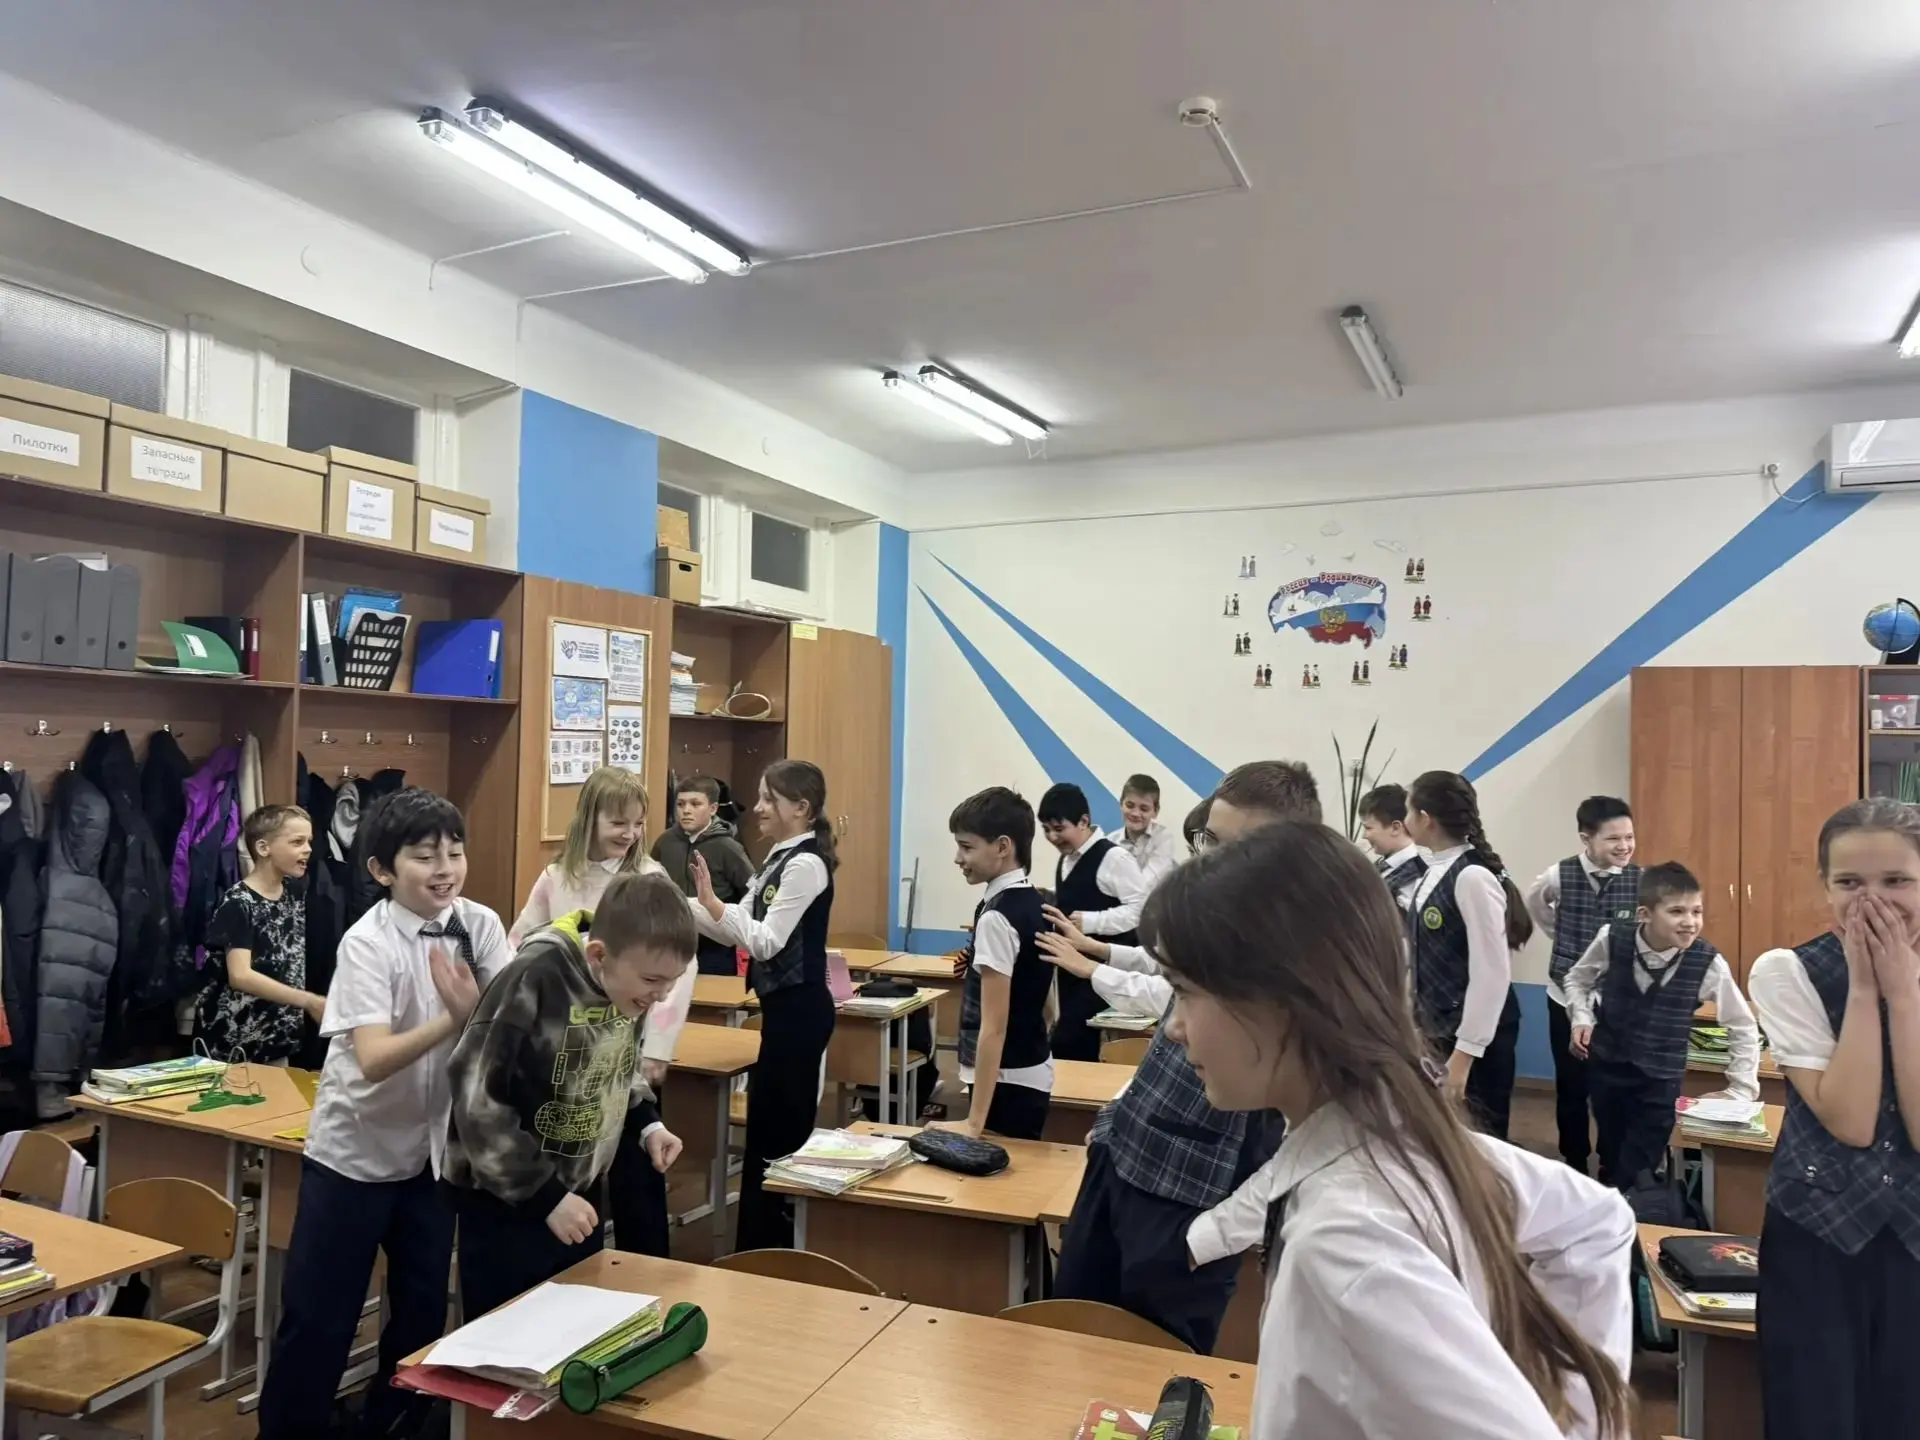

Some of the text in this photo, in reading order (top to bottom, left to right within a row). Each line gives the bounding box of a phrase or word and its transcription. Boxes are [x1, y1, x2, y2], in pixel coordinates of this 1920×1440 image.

[12, 433, 68, 454] Пилотки
[142, 445, 196, 464] Запасные
[147, 466, 190, 480] тетради
[1280, 578, 1309, 594] Россия
[1319, 573, 1352, 584] Родина
